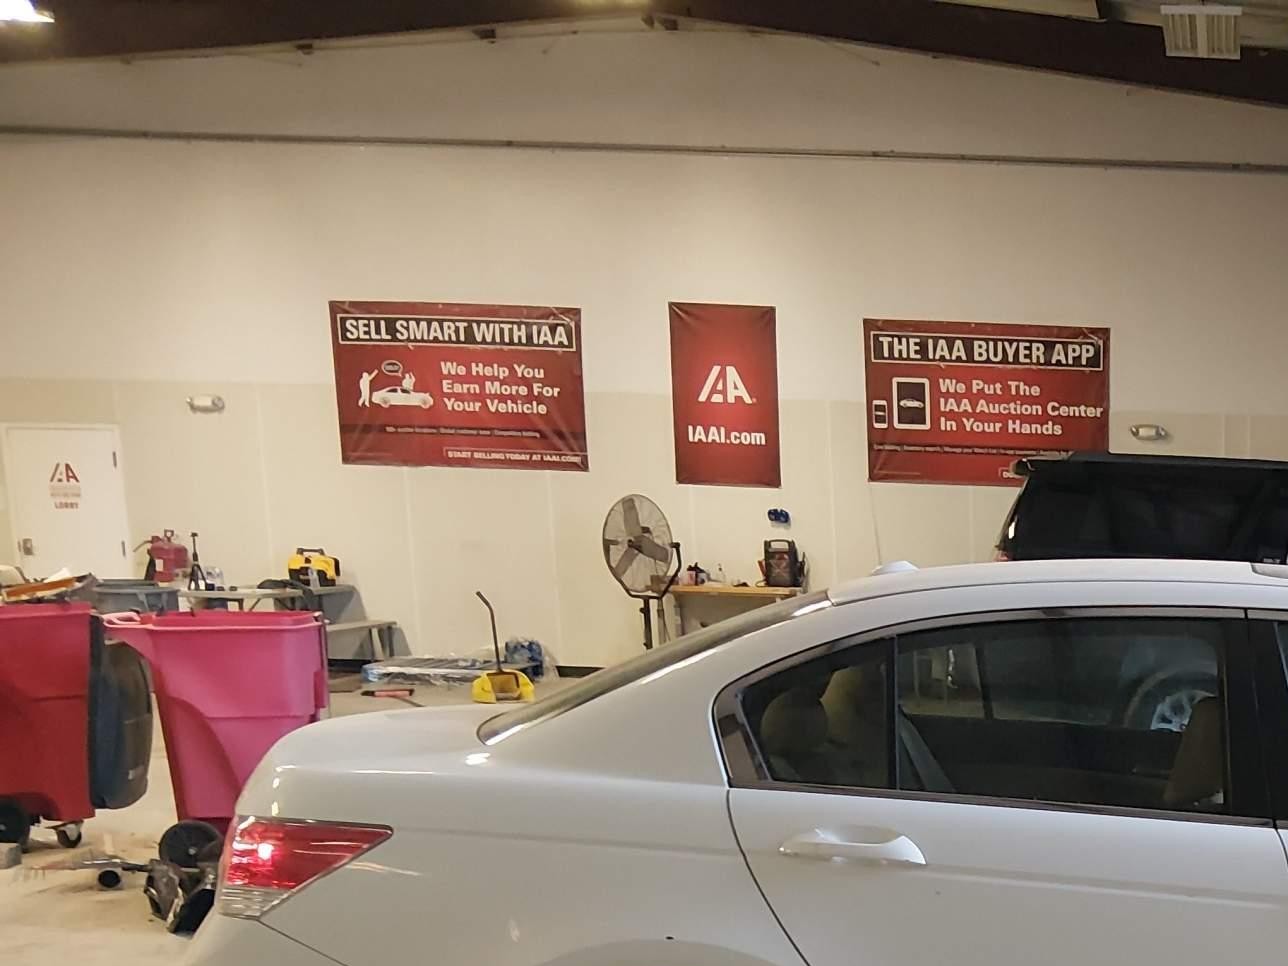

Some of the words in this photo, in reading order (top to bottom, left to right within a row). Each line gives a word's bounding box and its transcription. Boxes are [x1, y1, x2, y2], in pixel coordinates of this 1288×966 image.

[345, 319, 392, 340] SELL
[395, 320, 468, 342] SMART
[472, 322, 526, 344] WITH
[532, 324, 569, 346] IAA
[879, 336, 921, 360] THE
[928, 338, 967, 361] IAA
[973, 340, 1045, 364] BUYER
[1051, 343, 1095, 366] APP
[440, 361, 466, 376] We
[471, 362, 509, 380] Help
[513, 364, 545, 379] You
[442, 379, 480, 394] Earn
[485, 381, 528, 396] More
[533, 383, 560, 397] For
[939, 378, 966, 394] We
[972, 380, 1002, 395] Put
[1008, 381, 1041, 396] The
[443, 397, 482, 412] Your
[486, 399, 547, 415] Vehicle
[939, 398, 973, 413] IAA
[976, 399, 1043, 416] Auction
[1047, 402, 1104, 418] Center
[687, 424, 766, 446] IAAI.com
[940, 417, 957, 431] In
[962, 418, 1002, 433] Your
[1008, 420, 1063, 435] Hands
